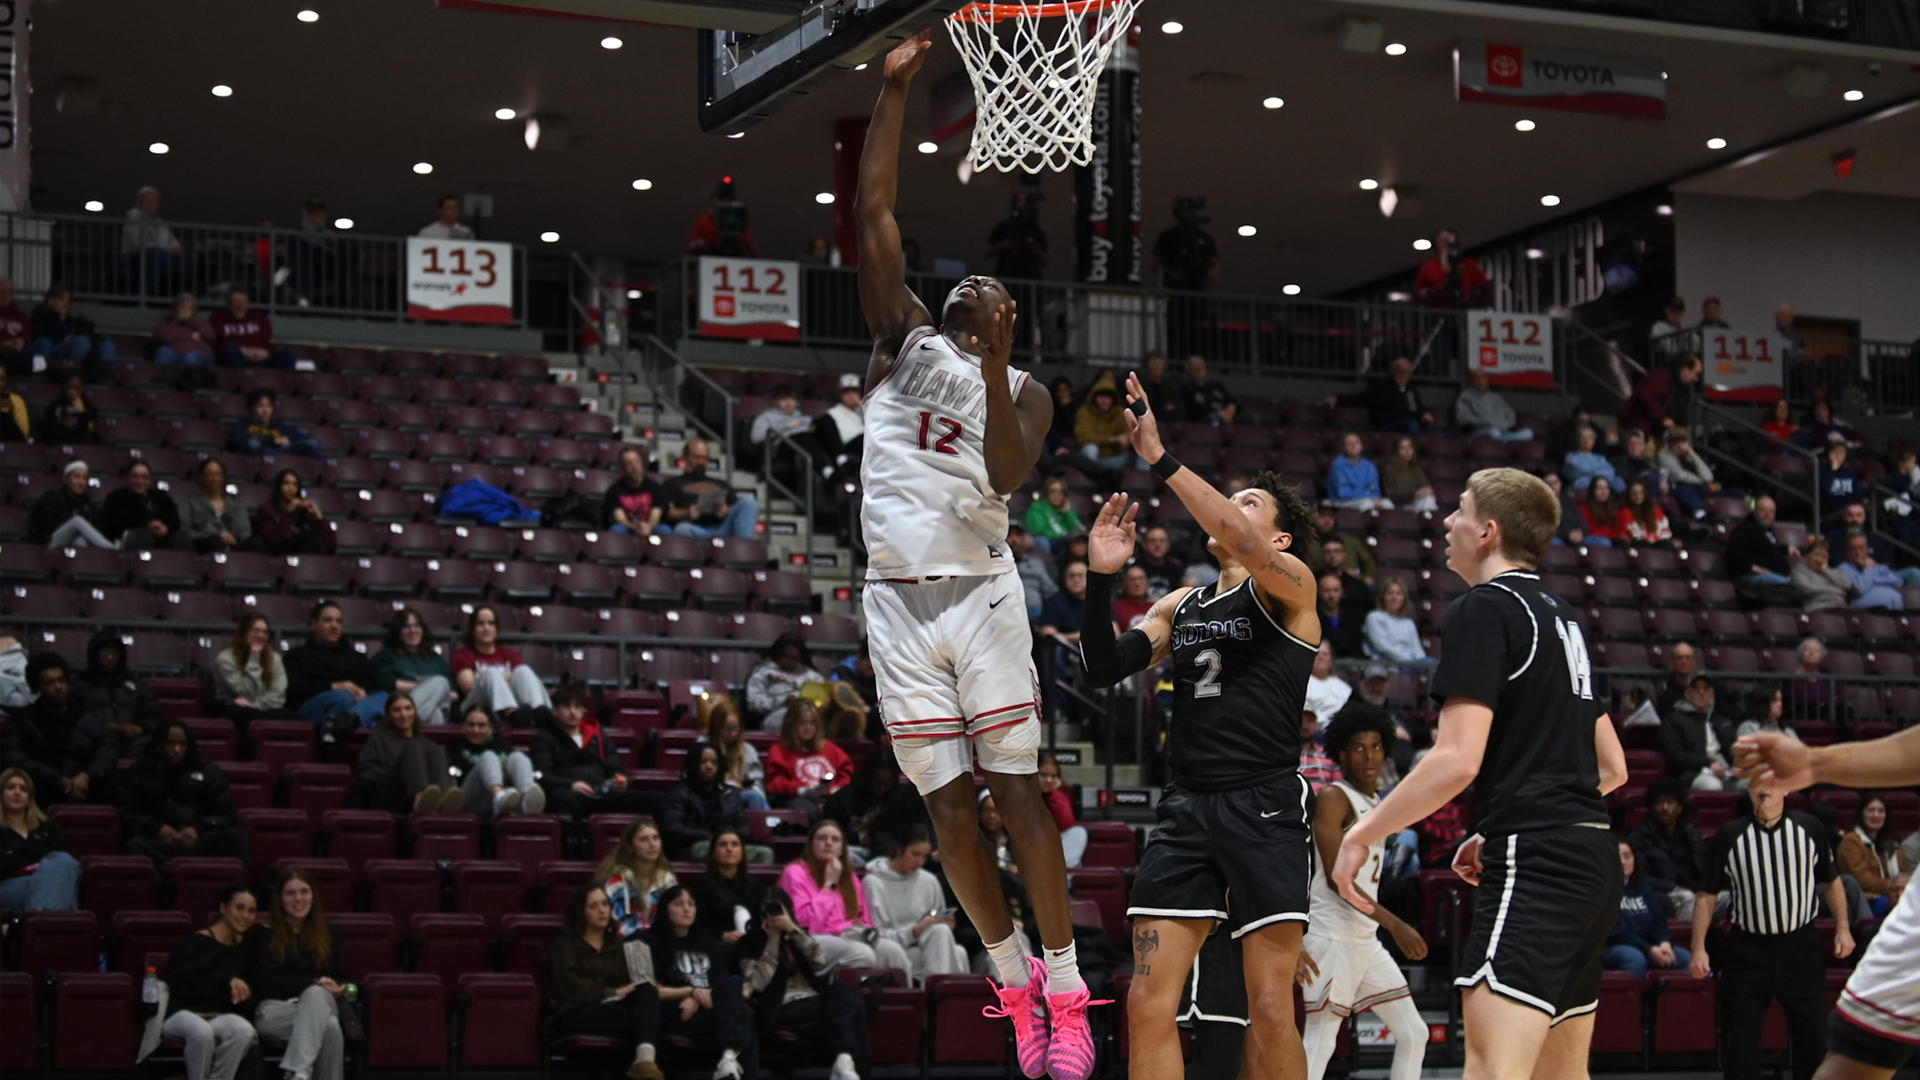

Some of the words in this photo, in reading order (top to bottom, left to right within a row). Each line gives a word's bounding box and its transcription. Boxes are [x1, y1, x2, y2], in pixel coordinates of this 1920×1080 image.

[1530, 60, 1615, 86] TOYOTA
[422, 246, 497, 288] 113
[1086, 234, 1114, 283] buy
[713, 265, 787, 296] 112
[740, 302, 791, 315] TOYOTA
[1478, 318, 1542, 347] 112
[1502, 352, 1545, 365] TOYOTA
[1713, 335, 1774, 362] 111
[916, 411, 965, 457] 12
[1555, 615, 1593, 700] 14
[1194, 648, 1223, 699] 2
[1371, 854, 1380, 883] 2
